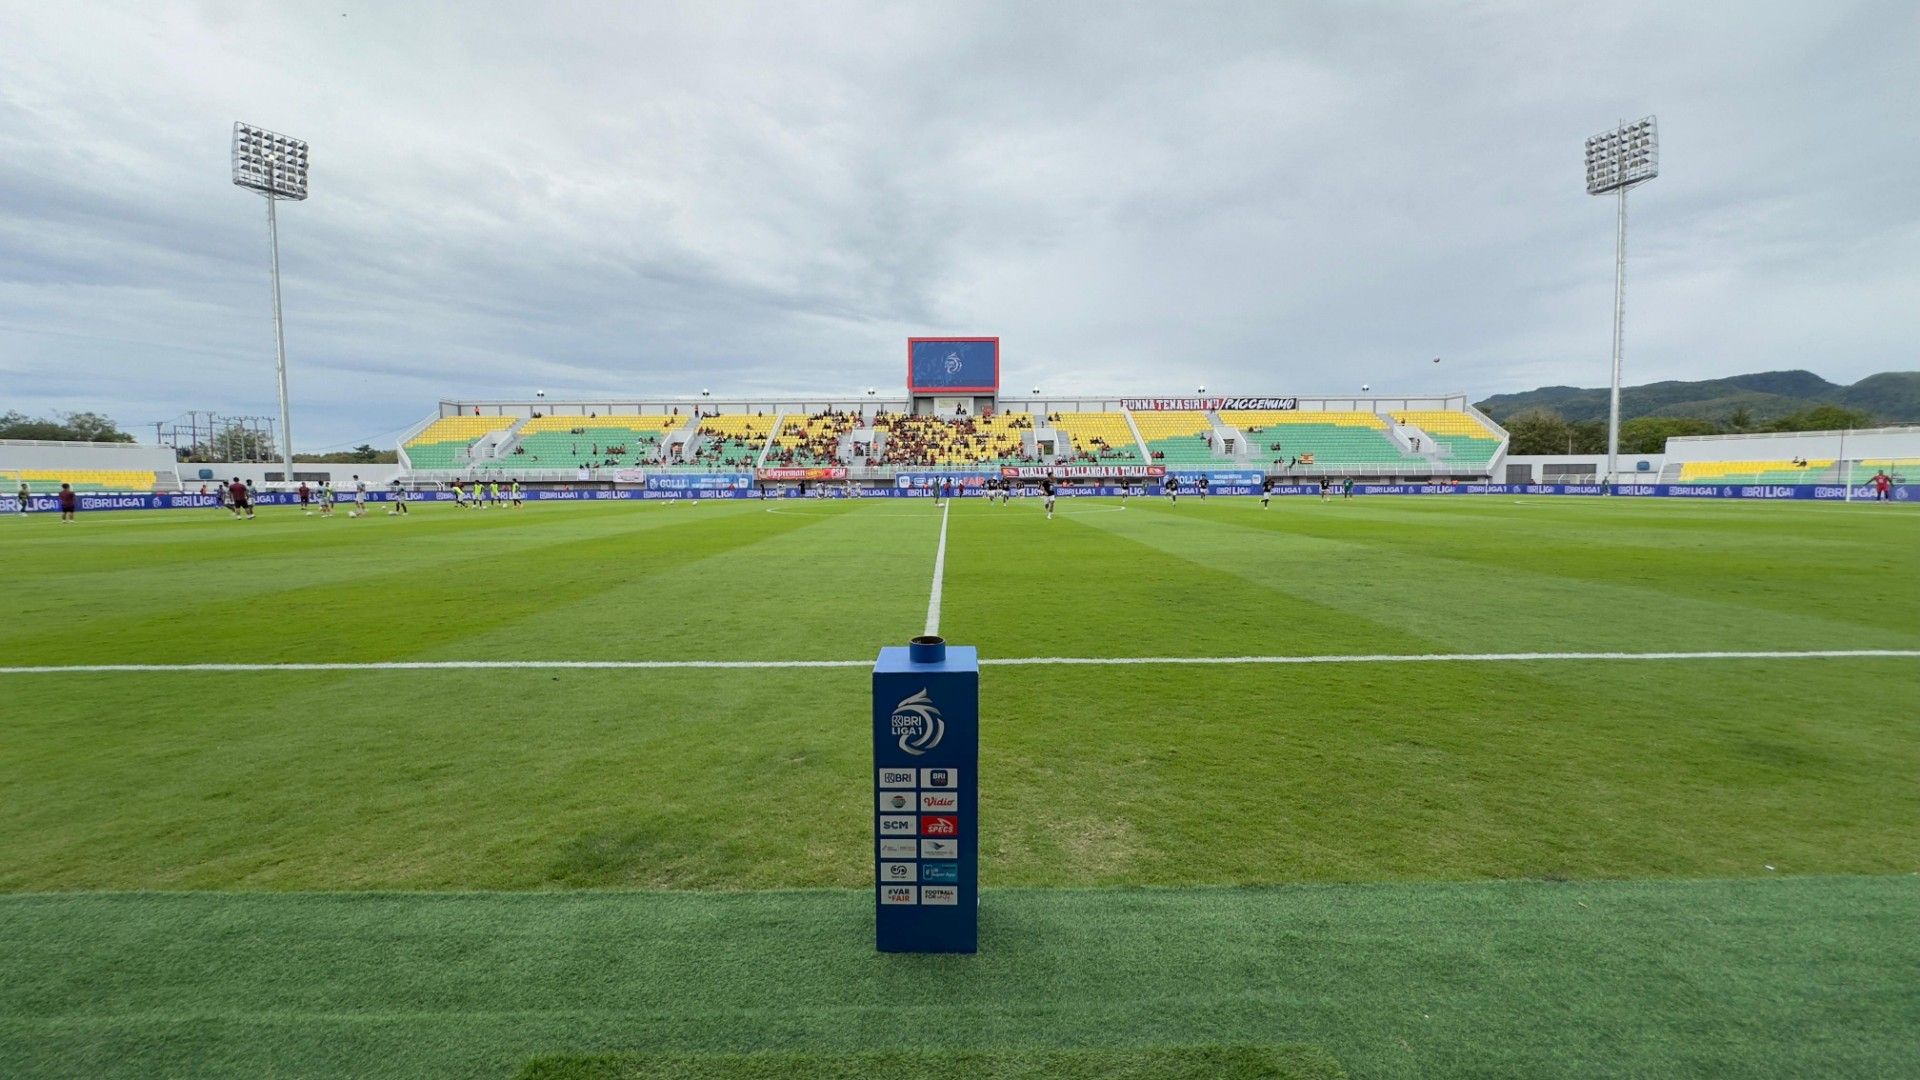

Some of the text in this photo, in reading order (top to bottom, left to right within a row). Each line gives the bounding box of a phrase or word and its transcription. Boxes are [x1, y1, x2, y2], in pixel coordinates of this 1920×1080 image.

[1677, 487, 1691, 496] BRI
[1827, 487, 1845, 497] BRI
[94, 498, 112, 508] BRI
[904, 716, 921, 726] BRI
[892, 727, 916, 735] LIGA
[895, 773, 911, 782] BRI
[924, 796, 955, 807] Vidio
[883, 821, 908, 829] SCM
